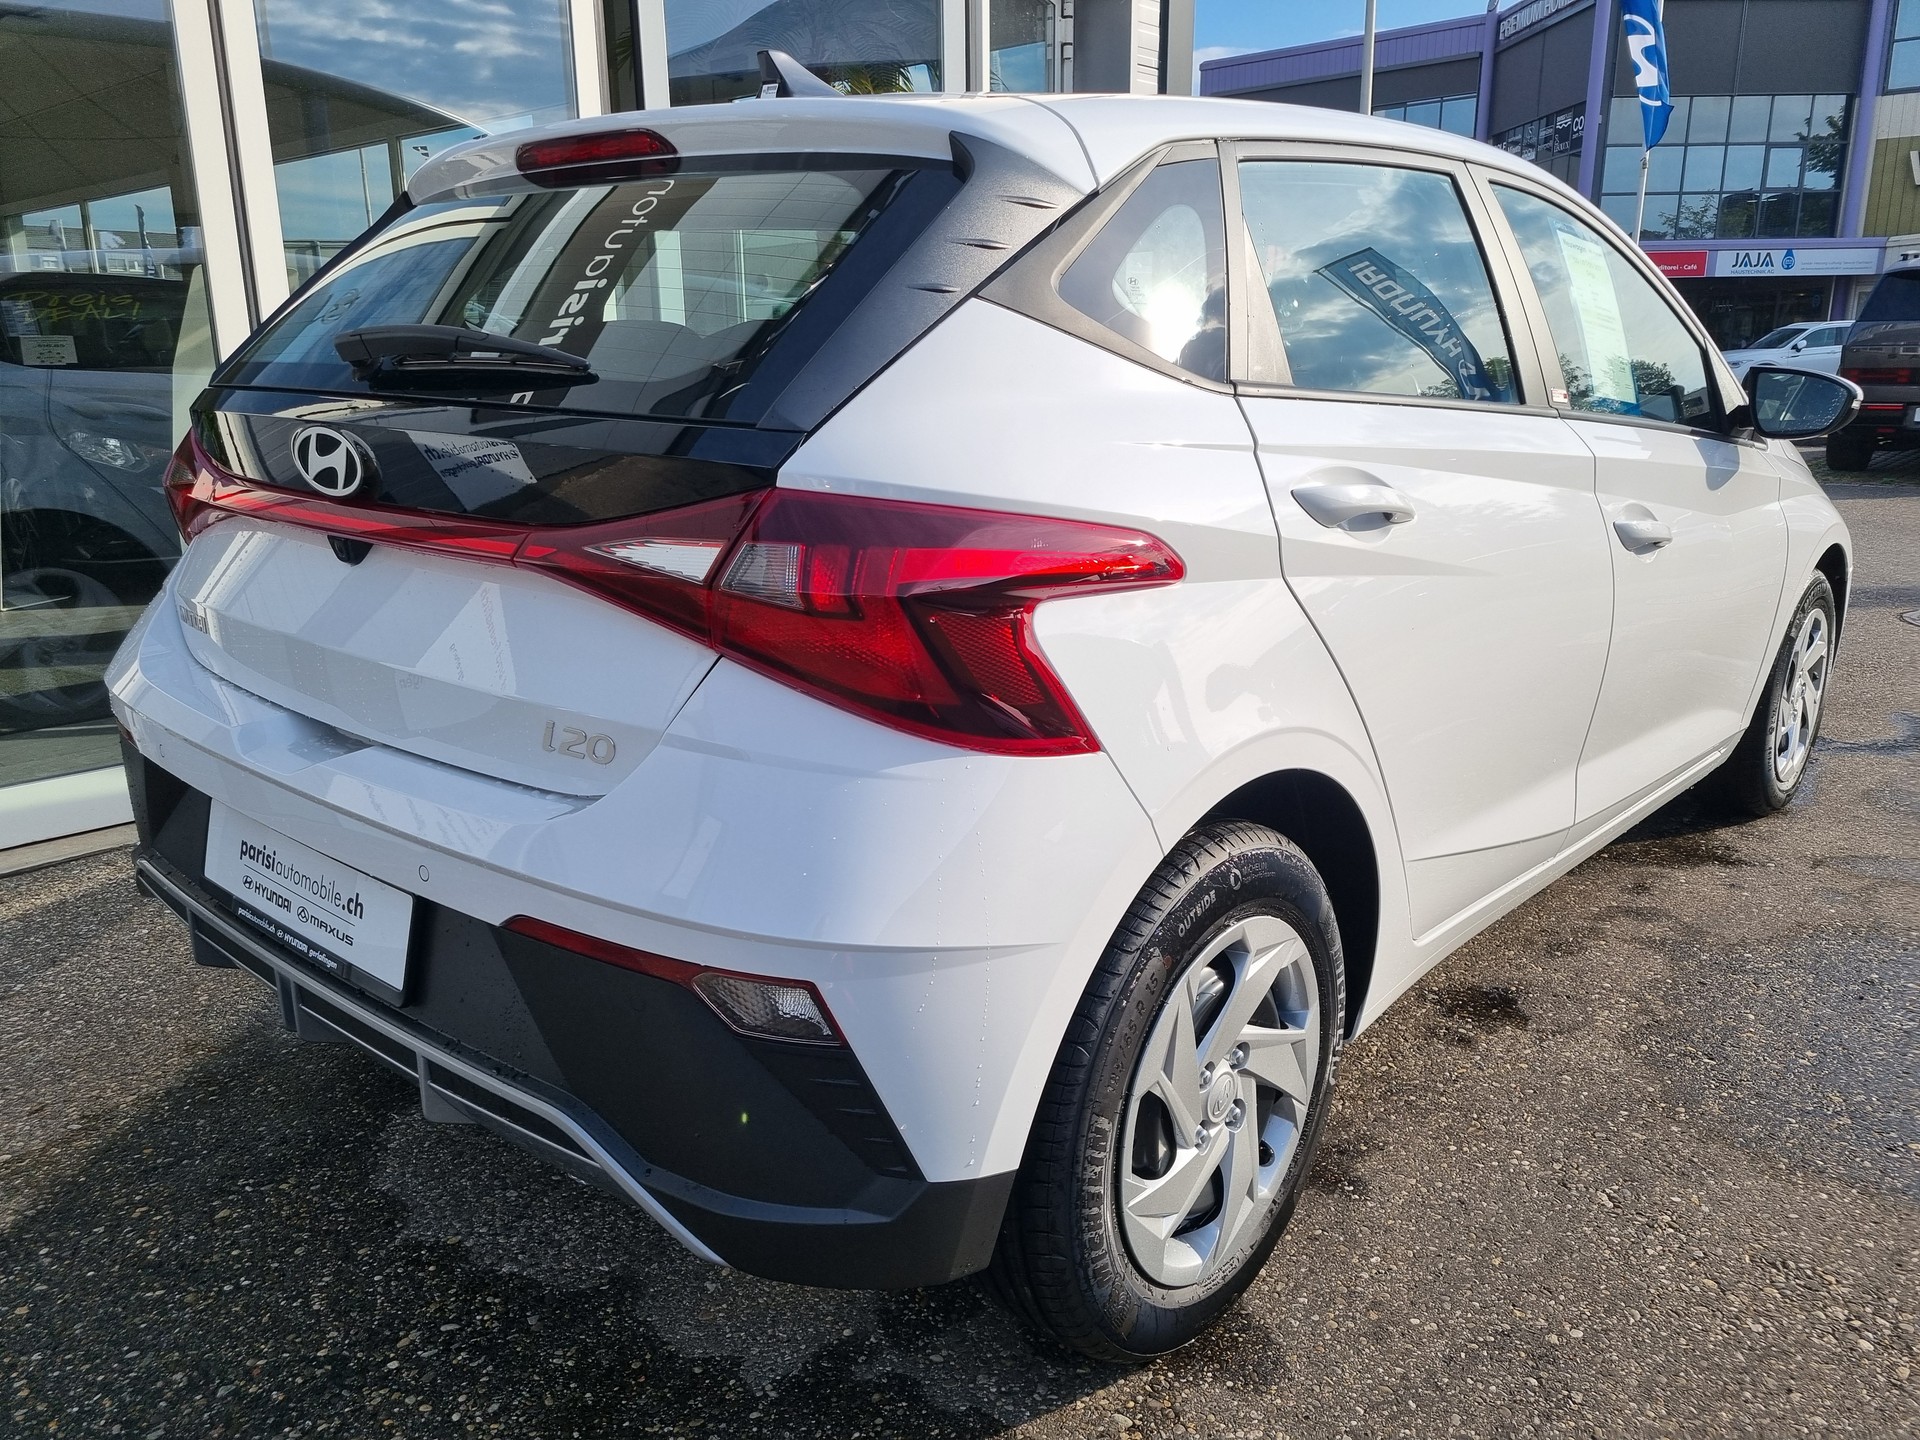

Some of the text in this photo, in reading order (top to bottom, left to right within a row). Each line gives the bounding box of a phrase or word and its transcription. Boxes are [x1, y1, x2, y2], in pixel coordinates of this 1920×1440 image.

[1499, 1, 1544, 40] PREMIUM
[1683, 263, 1698, 271] Café
[1732, 252, 1774, 268] JAJA
[2, 290, 134, 307] Preis
[240, 839, 364, 920] parisiautomobile.ch
[237, 907, 276, 934] parisiautomobile.ch
[284, 933, 309, 953] HYUNDAI
[254, 881, 354, 947] HYUNDAI MAXUS
[1178, 889, 1217, 938] OUTSIDE
